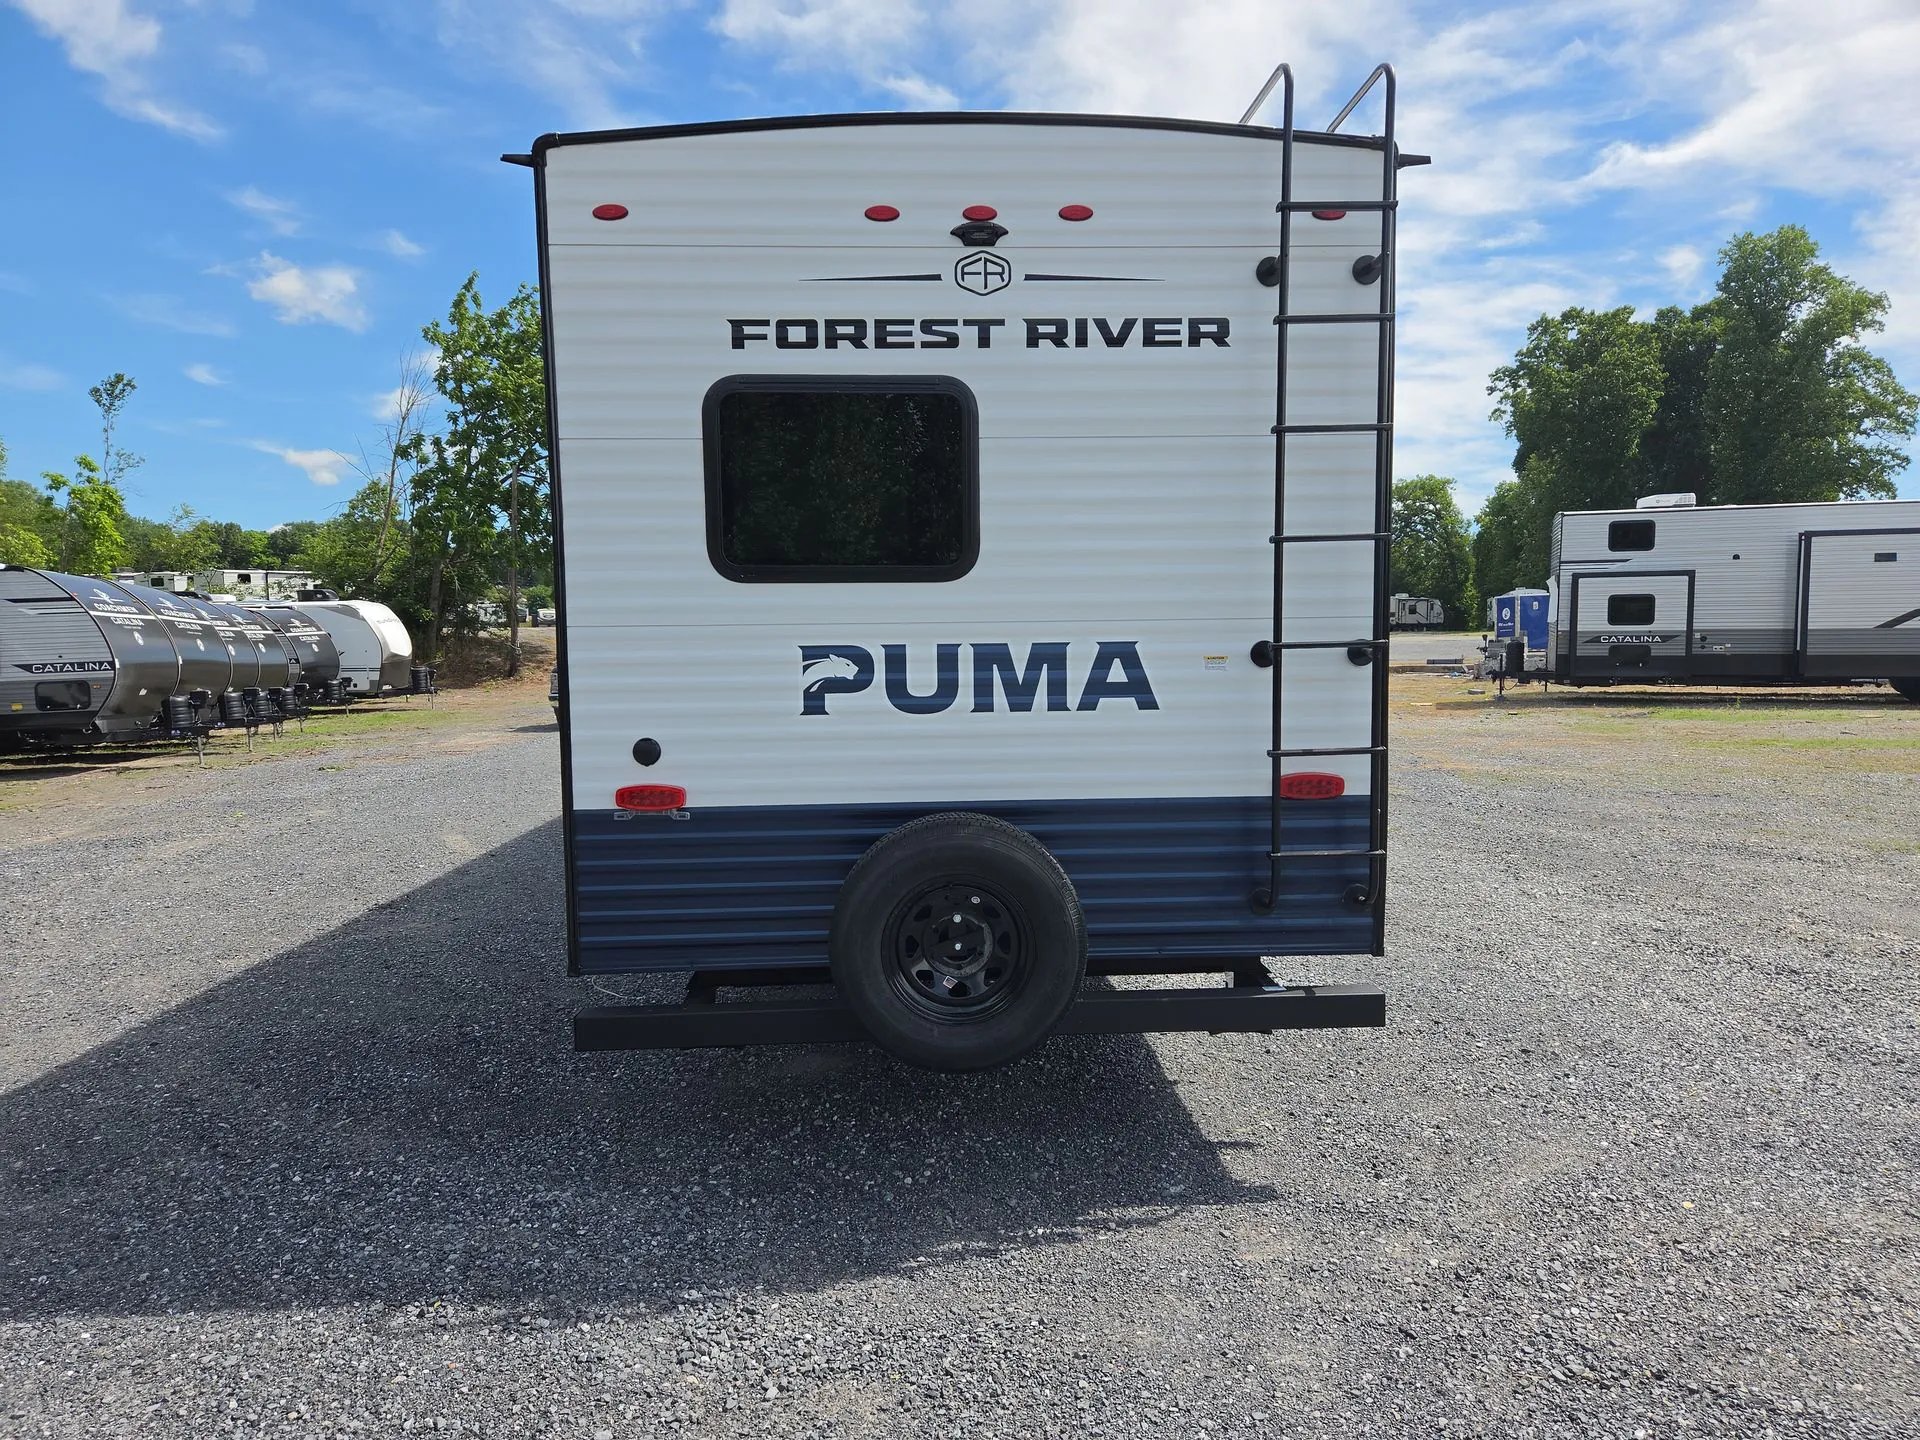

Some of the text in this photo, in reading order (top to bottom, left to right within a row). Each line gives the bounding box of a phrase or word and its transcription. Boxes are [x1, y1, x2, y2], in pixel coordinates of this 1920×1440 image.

[961, 257, 1005, 290] FR
[726, 317, 1232, 350] FOREST RIVER
[94, 602, 139, 613] COACHMEN
[110, 616, 145, 626] CATALINA
[1600, 635, 1662, 643] CATALINA
[32, 662, 111, 673] CATALINA
[797, 641, 1160, 716] PUMA
